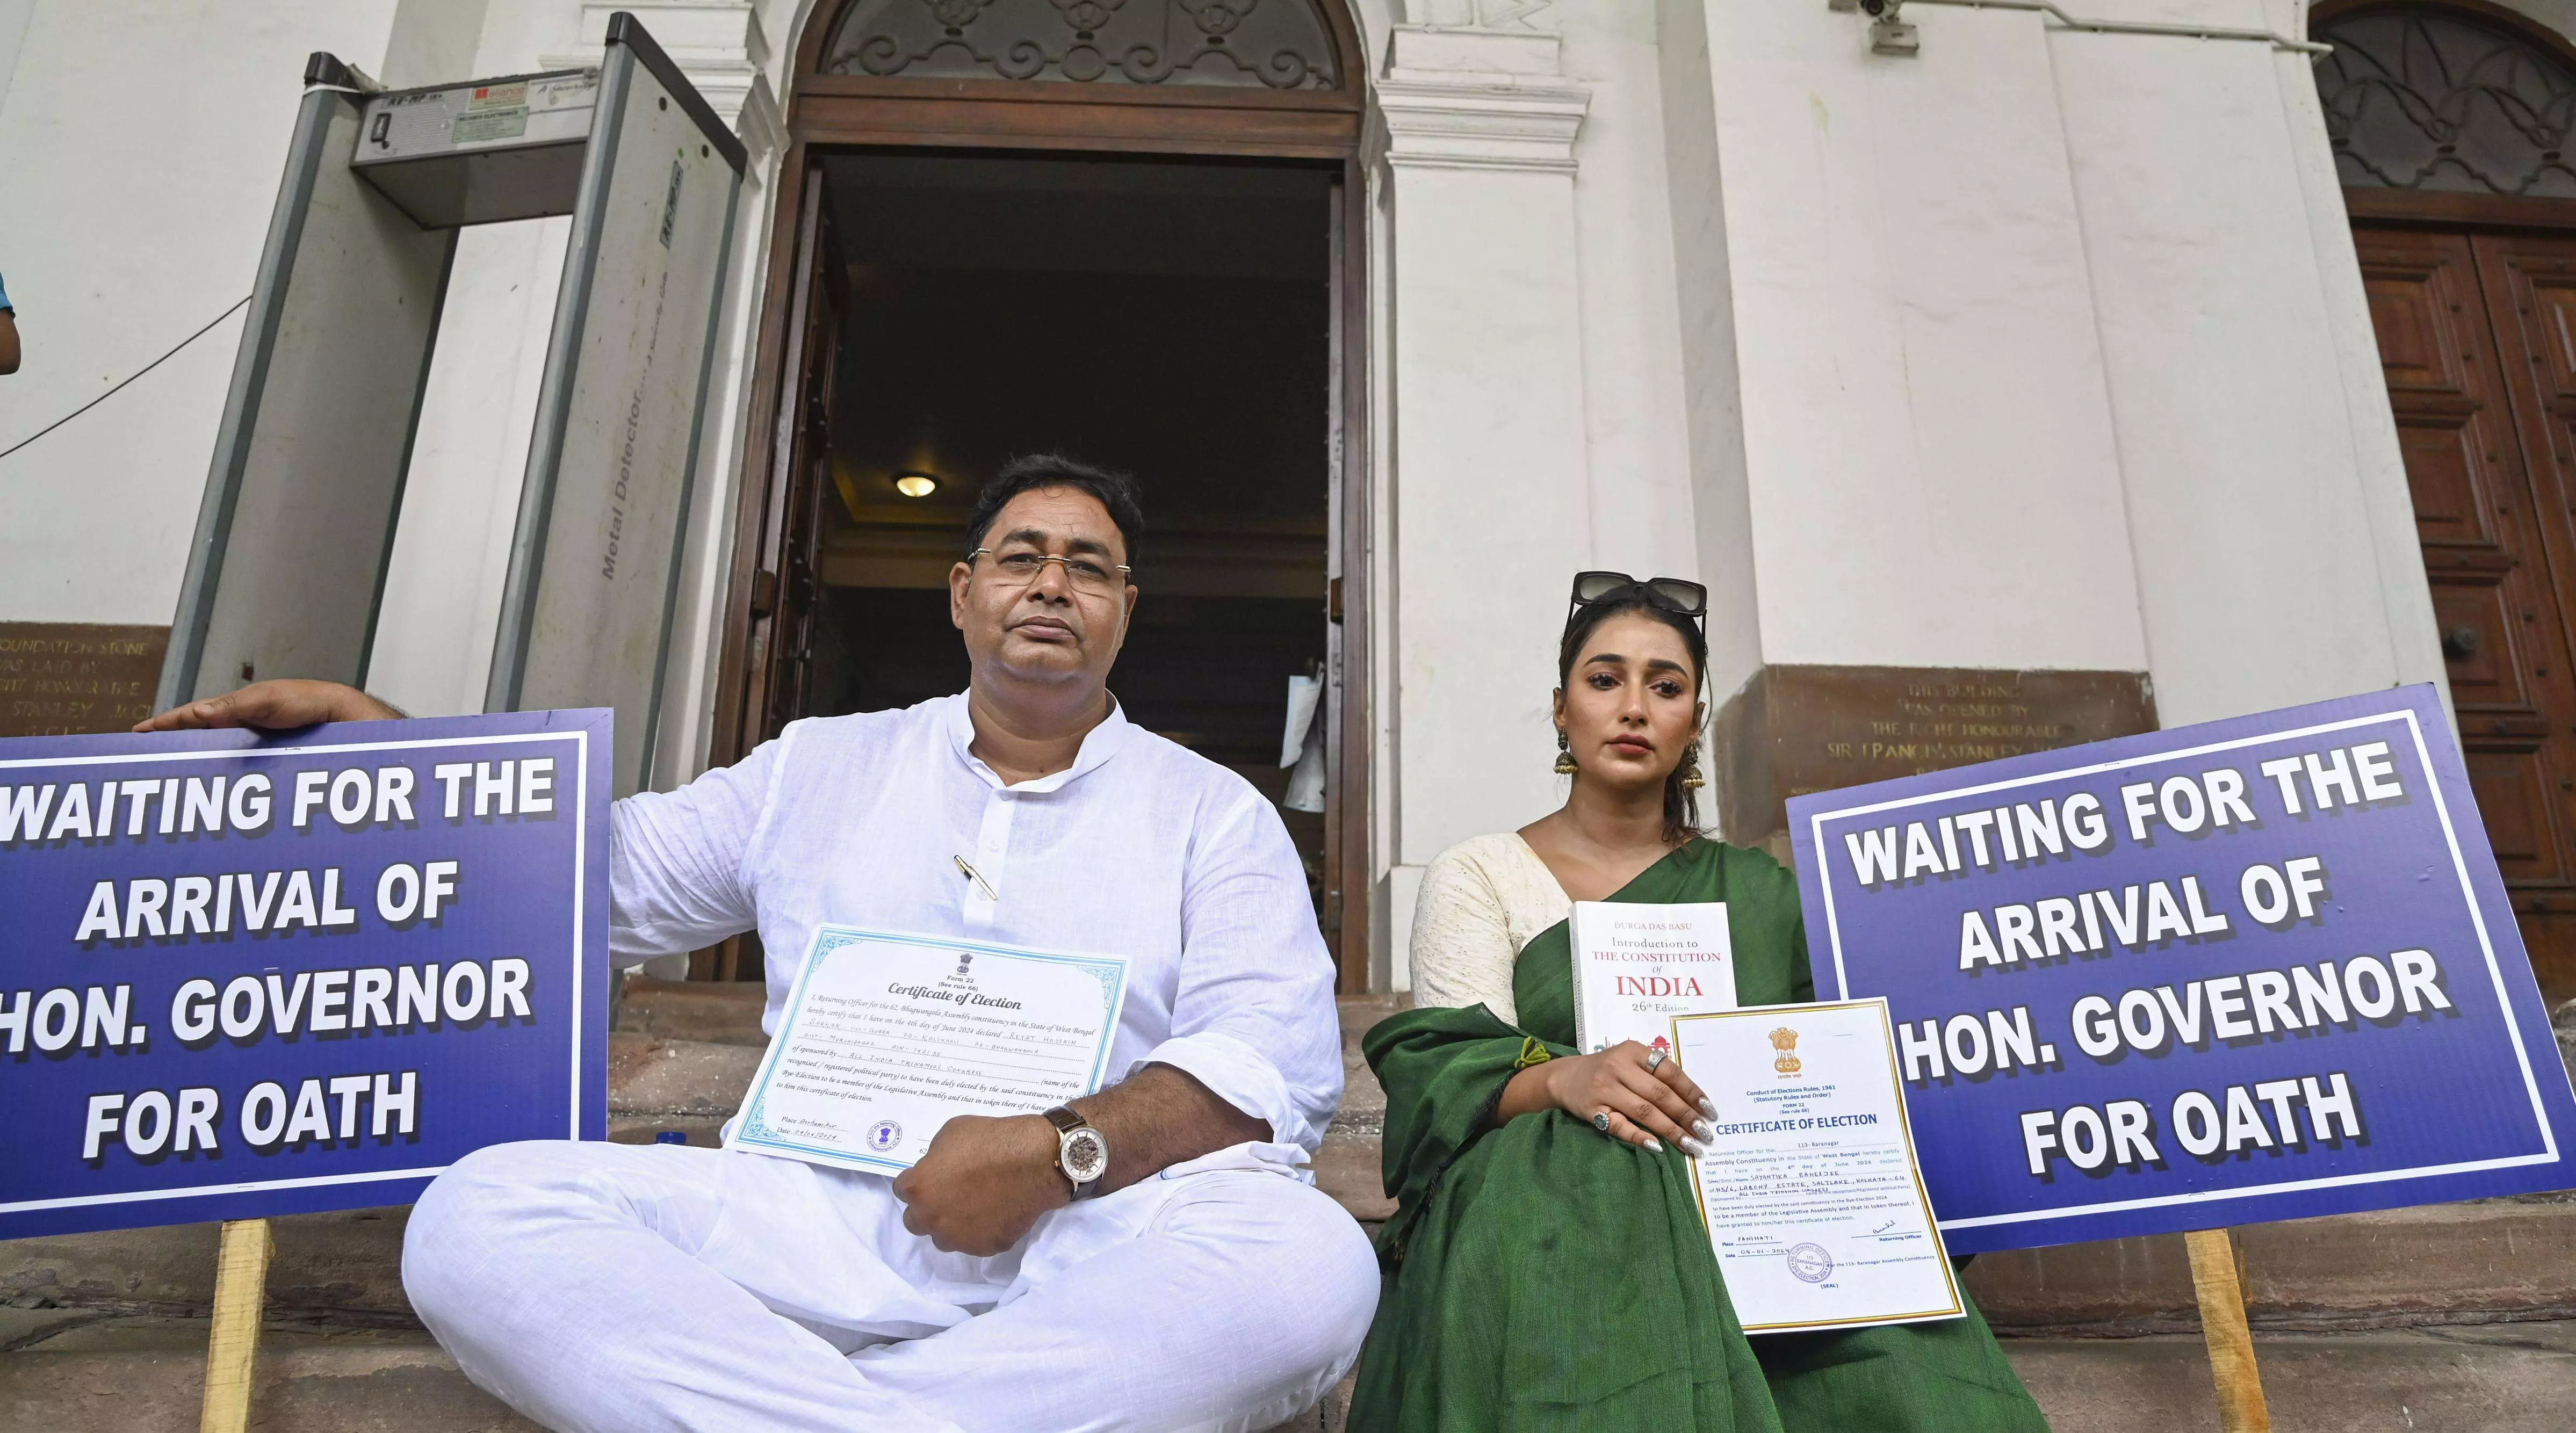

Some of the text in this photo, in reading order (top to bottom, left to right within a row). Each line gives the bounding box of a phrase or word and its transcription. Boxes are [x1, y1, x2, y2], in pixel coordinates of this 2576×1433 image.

[602, 506, 623, 580] Metal
[0, 639, 92, 654] OUNDATION
[1827, 742, 1851, 758] SIR
[0, 758, 554, 842] WAITING FOR THE
[1844, 741, 2403, 885] WAITING FOR THE
[75, 862, 457, 940] ARRIVAL OF
[1960, 857, 2324, 969] ARRIVAL OF
[1614, 921, 1692, 931] DURGA DAS BASU
[1612, 937, 1698, 948] Introduction to
[1592, 950, 1721, 962] THE CONSTITUTION
[1652, 965, 1663, 975] Of
[888, 982, 1022, 1010] Certificate of Election
[1615, 975, 1705, 996] INDIA
[171, 959, 531, 1038] GOVERNOR
[1632, 1001, 1690, 1012] 26th Edition
[818, 995, 847, 1005] Returning
[848, 998, 869, 1009] Officer
[867, 1001, 879, 1009] for
[890, 1004, 898, 1012] 62,
[900, 1005, 941, 1017] Bhagwangola
[941, 1011, 971, 1022] Assembly
[971, 1016, 1009, 1027] constituency
[1047, 1024, 1055, 1032] of
[1055, 1024, 1071, 1032] West
[1072, 1027, 1095, 1036] Bengal
[1898, 950, 2452, 1081] HON. GOVERNOR
[809, 1088, 839, 1096] certificate
[840, 1091, 849, 1099] of
[848, 1092, 872, 1102] election.
[83, 1072, 416, 1159] FOR OATH
[1716, 1113, 1877, 1135] CERTIFICATE OF ELECTION
[2021, 1073, 2360, 1174] FOR OATH
[1790, 1244, 1814, 1262] RETURNING
[1796, 1258, 1823, 1266] BARANAGAR
